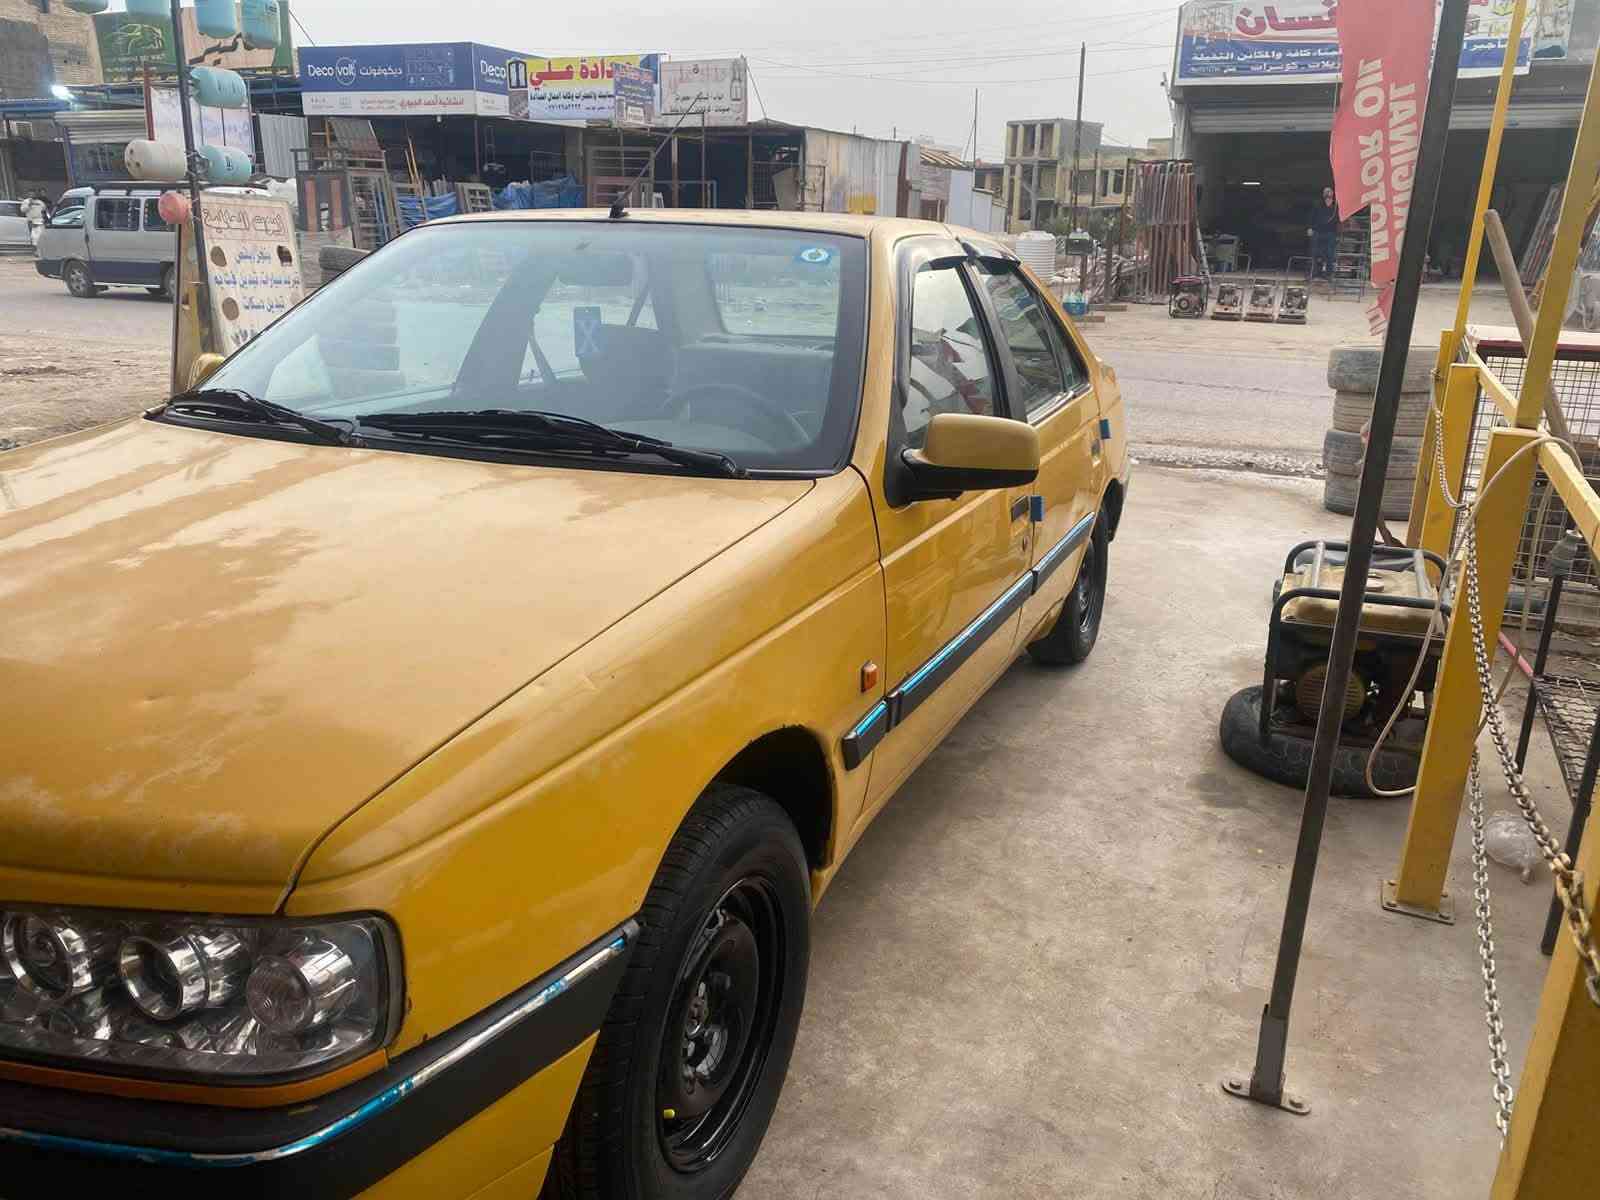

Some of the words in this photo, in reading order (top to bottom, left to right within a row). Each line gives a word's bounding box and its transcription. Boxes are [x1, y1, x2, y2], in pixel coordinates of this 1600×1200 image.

[307, 64, 335, 77] Deco
[479, 59, 507, 80] Deco
[529, 58, 575, 91] علي
[579, 57, 614, 80] دادة
